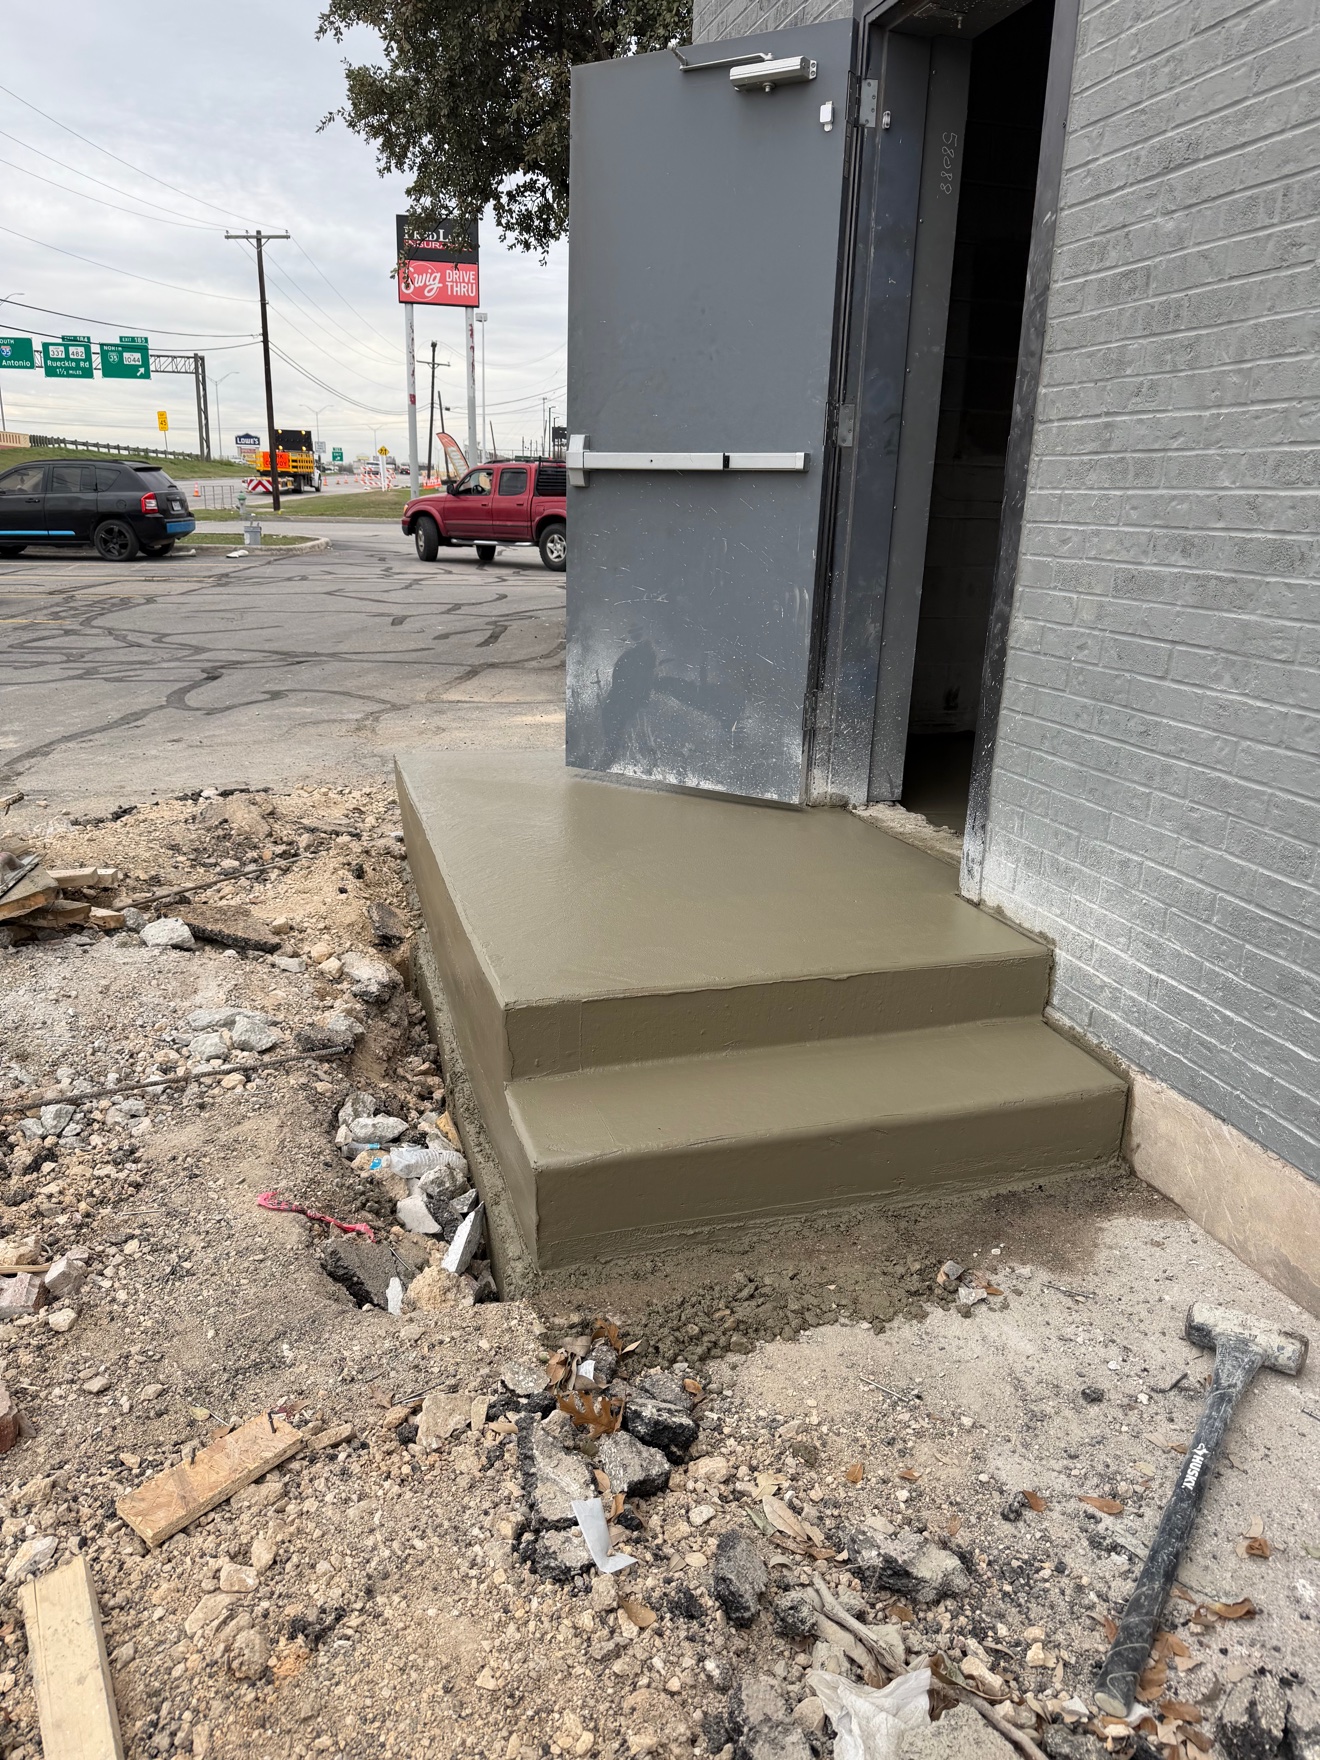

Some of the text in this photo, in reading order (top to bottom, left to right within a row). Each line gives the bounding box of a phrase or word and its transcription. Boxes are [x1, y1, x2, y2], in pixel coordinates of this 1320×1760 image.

[446, 269, 476, 283] DRIVE
[401, 266, 443, 297] Swig
[446, 282, 476, 297] THRU
[50, 349, 64, 357] 337
[70, 350, 84, 358] 482
[2, 359, 31, 367] Antonio
[47, 359, 90, 368] Rueckle Rd
[124, 356, 141, 364] 1044
[1183, 1455, 1204, 1490] HUSKY
